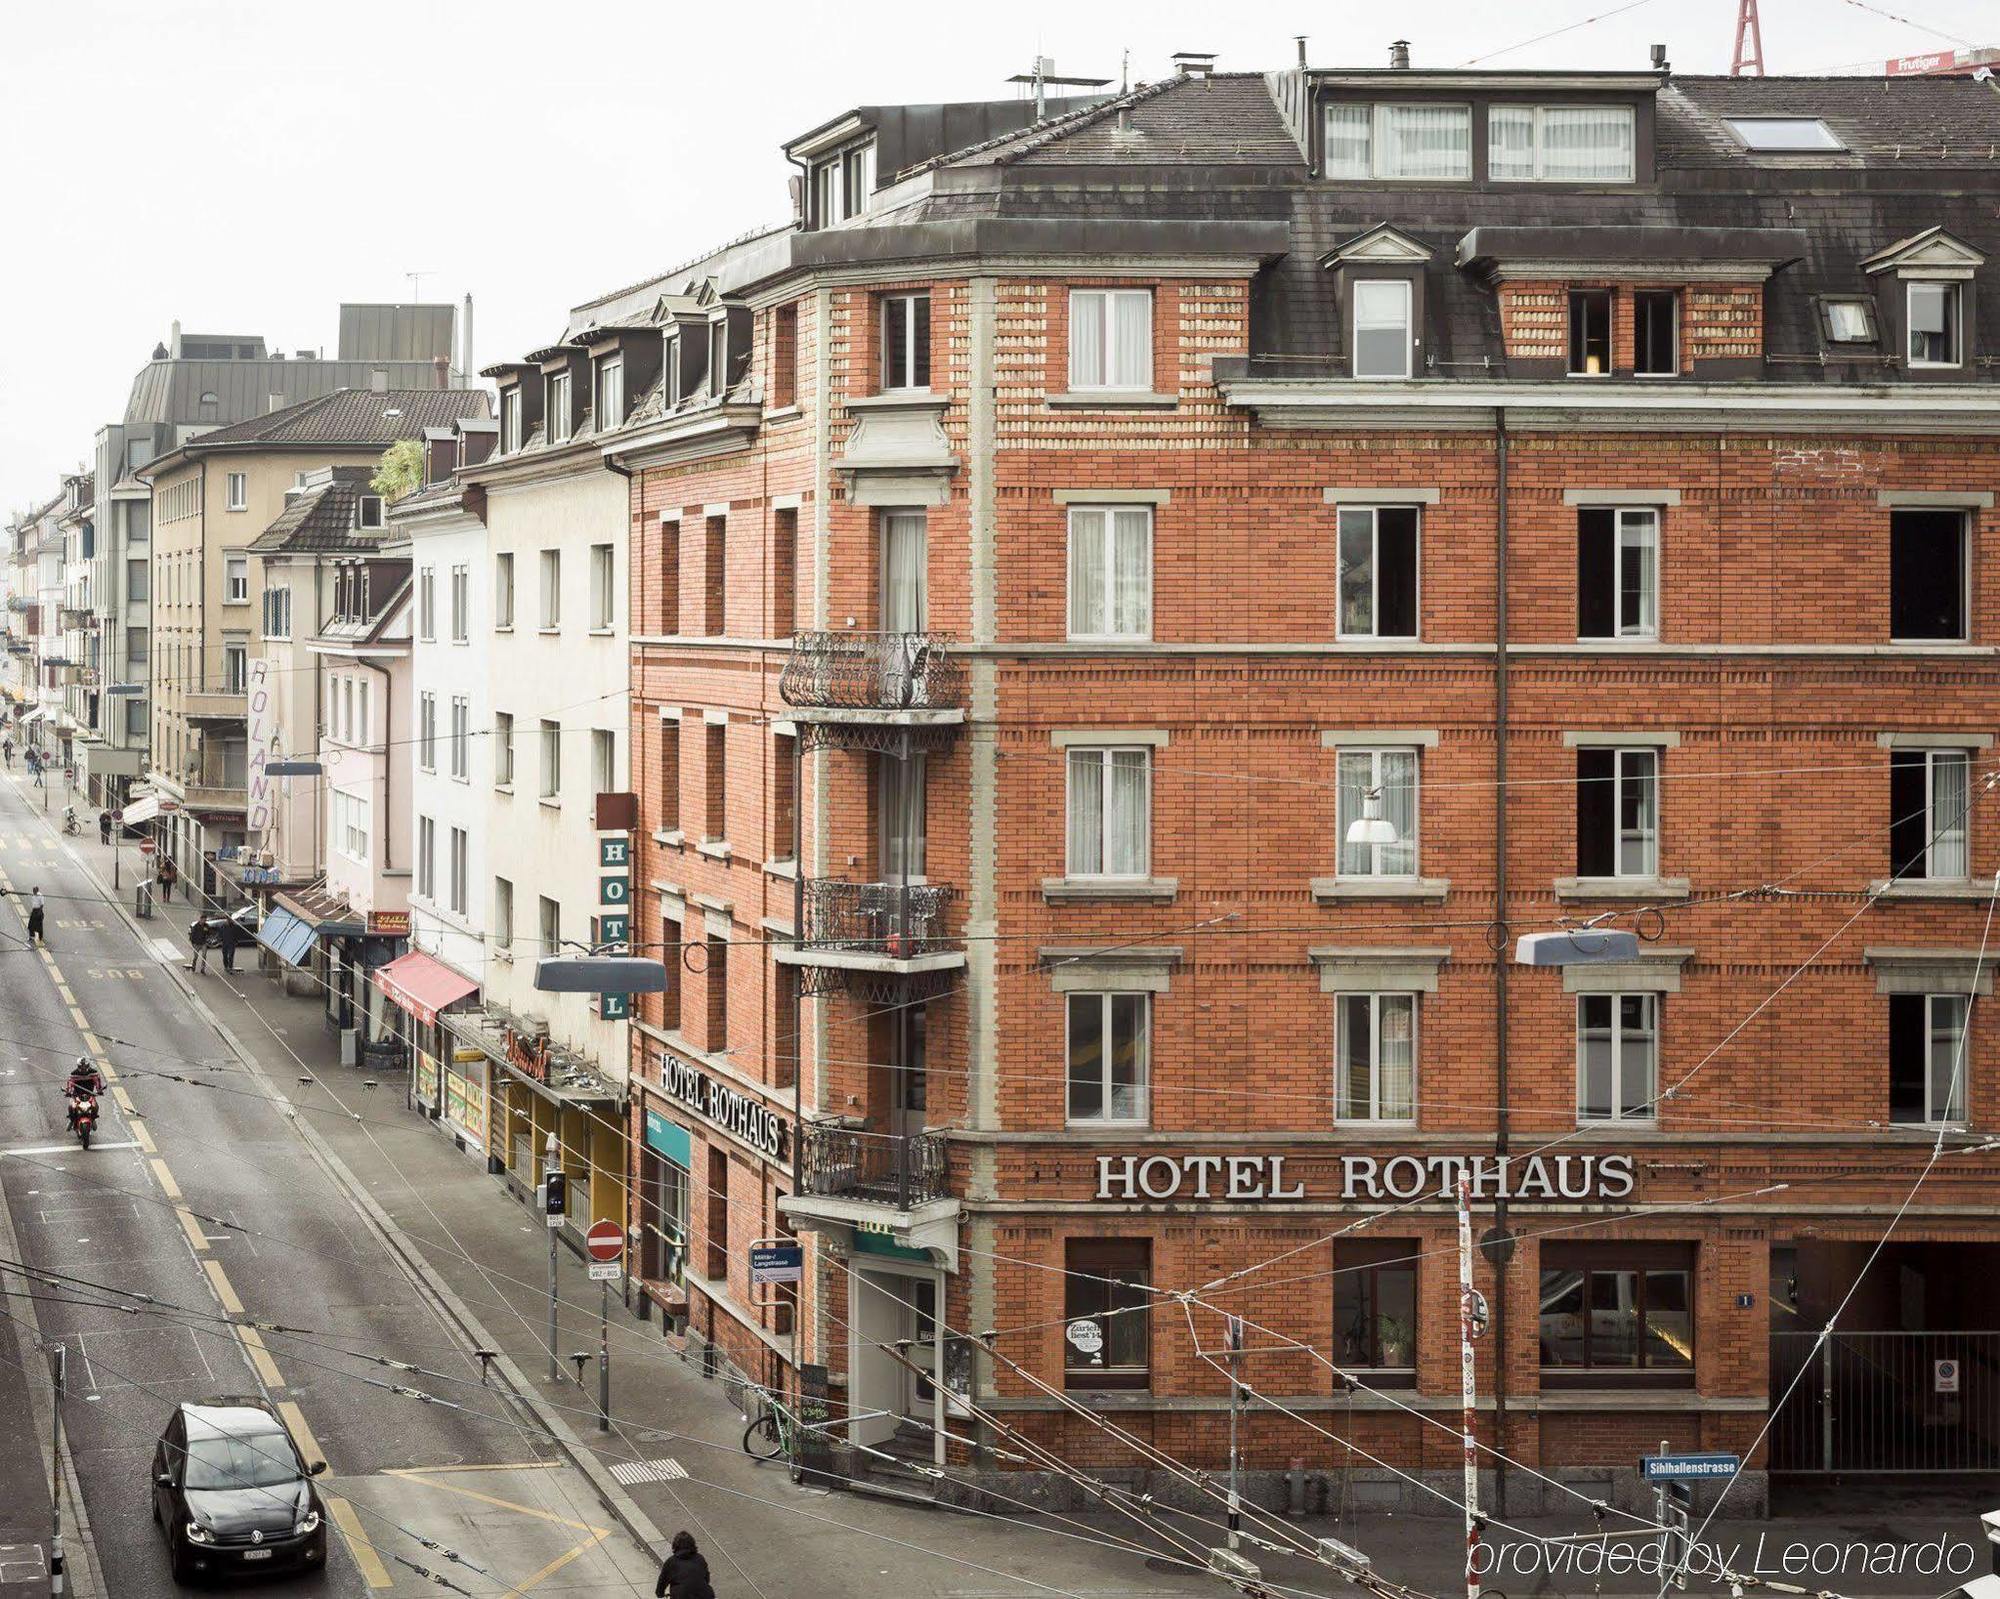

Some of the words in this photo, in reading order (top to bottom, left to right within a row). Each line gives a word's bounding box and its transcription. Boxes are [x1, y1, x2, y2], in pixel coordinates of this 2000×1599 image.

[249, 660, 269, 829] ROLAND
[605, 844, 625, 1014] HOTL
[660, 1052, 704, 1111] HOTEL
[709, 1080, 779, 1156] ROTHAUS
[1096, 1156, 1305, 1199] HOTEL
[1340, 1156, 1634, 1199] ROTHAUS
[1743, 1295, 1748, 1306] 1
[1650, 1462, 1735, 1474] Sihlhallenstrasse
